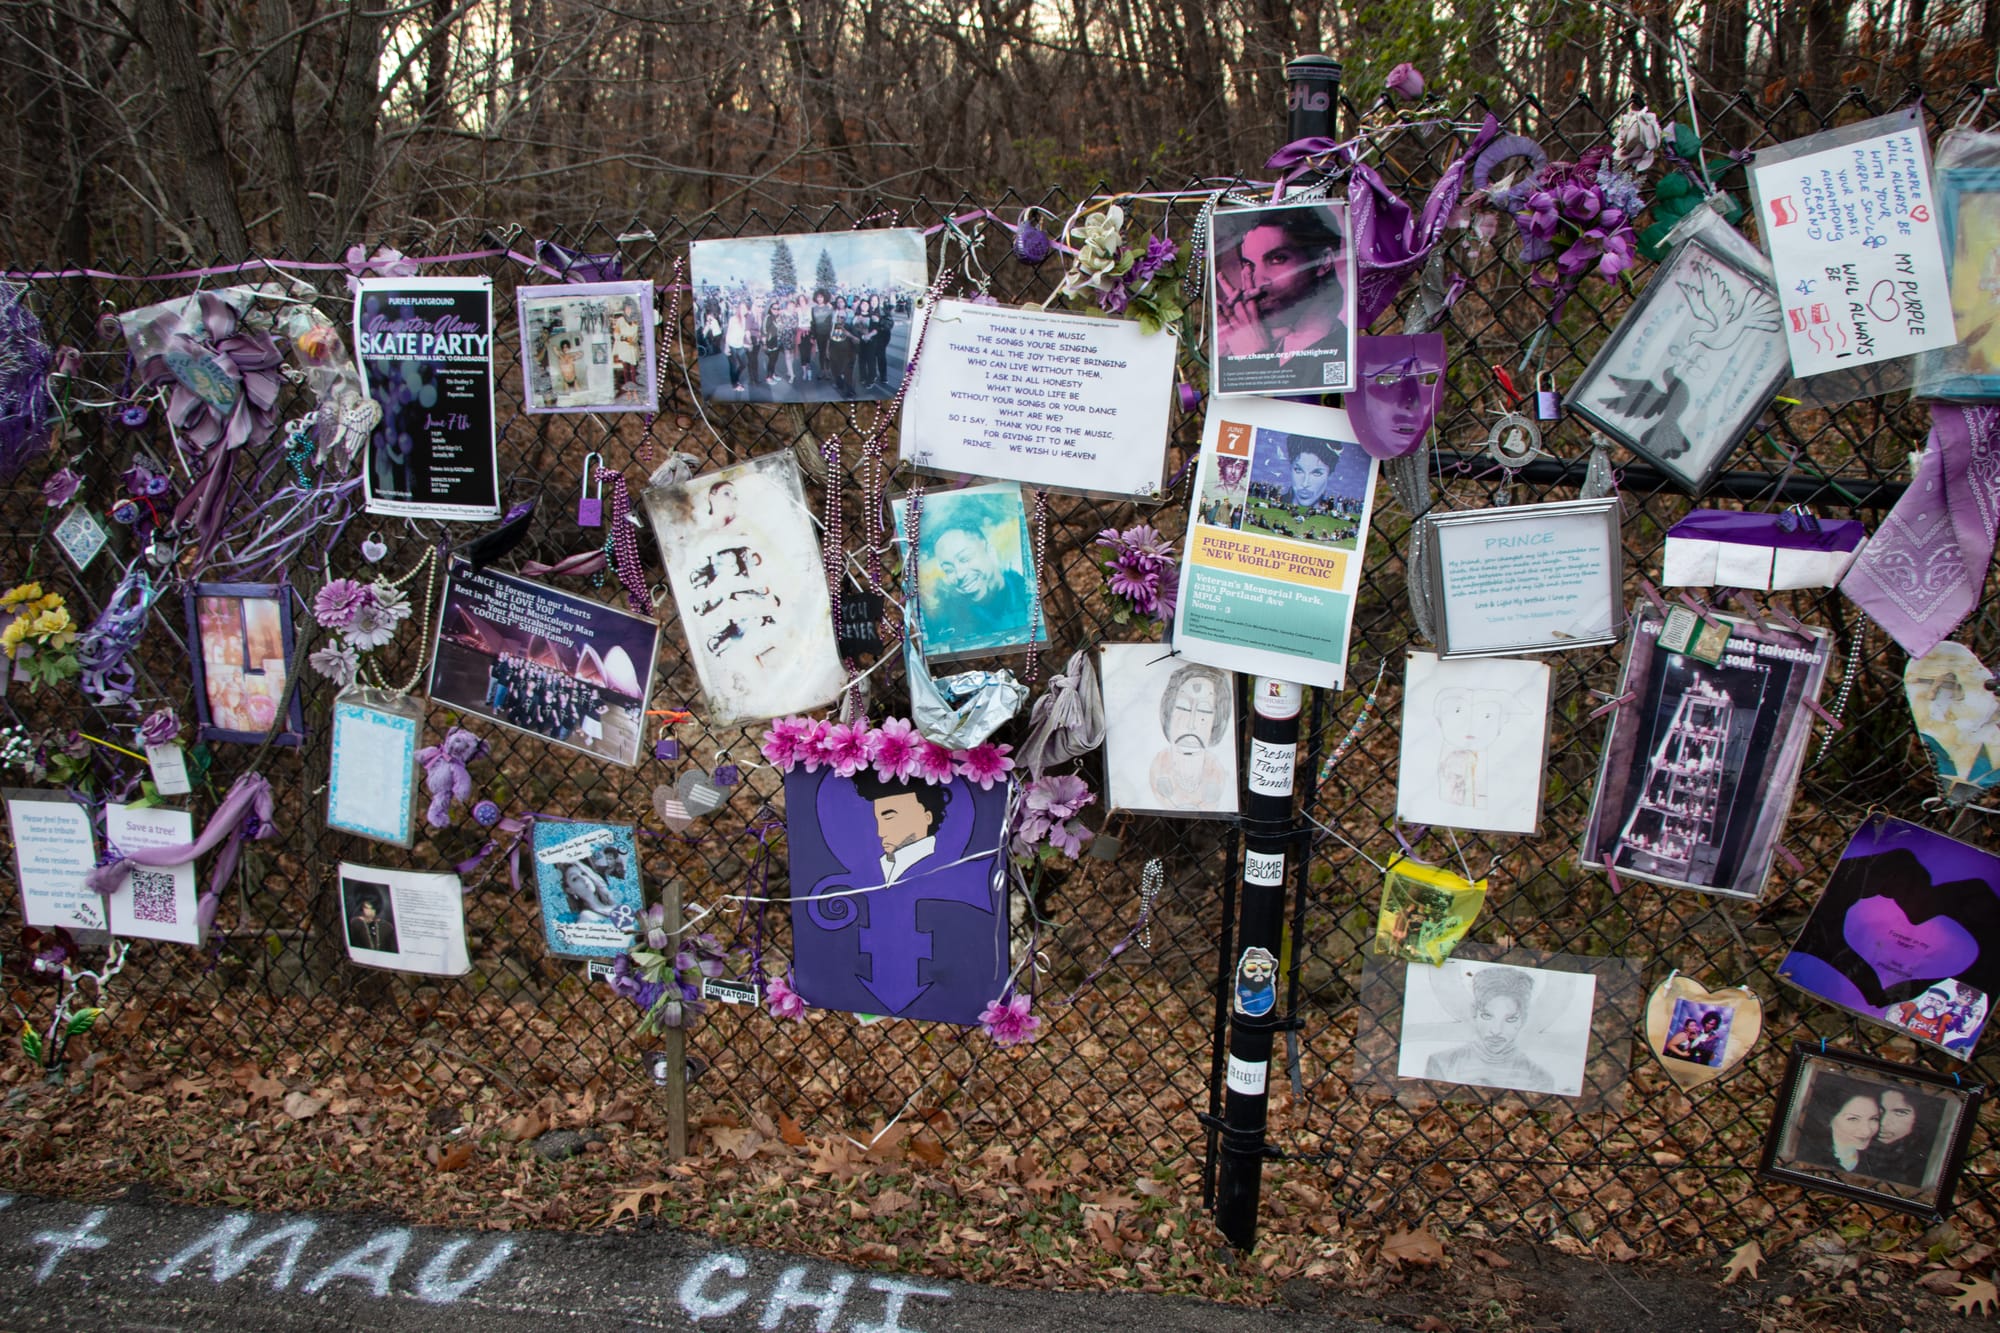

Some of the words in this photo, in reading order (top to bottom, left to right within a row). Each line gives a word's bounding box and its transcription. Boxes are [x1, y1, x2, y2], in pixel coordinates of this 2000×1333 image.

[1886, 140, 1898, 164] WILL
[1900, 137, 1913, 152] MY
[1870, 151, 1884, 178] WITH
[1836, 169, 1853, 195] YOUR
[1904, 159, 1921, 198] PURPLE
[1853, 150, 1869, 192] PURPLE
[1861, 199, 1875, 235] SOUL
[1891, 172, 1908, 214] ALWAYS
[1800, 177, 1821, 240] POLAND
[1813, 188, 1826, 219] FROM
[1874, 188, 1891, 220] YOUR
[1898, 221, 1910, 235] BE
[1825, 267, 1841, 281] BE
[1895, 254, 1914, 274] MY
[1842, 264, 1859, 295] WILL
[1898, 281, 1925, 335] PURPLE
[368, 314, 433, 337] Gangster
[433, 314, 481, 337] Glam
[990, 324, 1017, 335] THANK
[1038, 329, 1054, 338] THE
[1057, 331, 1086, 341] MUSIC
[1849, 302, 1875, 356] ALWAYS
[361, 332, 417, 354] SKATE
[422, 333, 488, 355] PARTY
[976, 335, 993, 344] THE
[995, 337, 1024, 347] SONGS
[1027, 340, 1056, 351] YOU'RE
[1059, 344, 1097, 354] SINGING
[949, 343, 980, 354] THANKS
[990, 349, 1005, 357] ALL
[1008, 351, 1024, 360] THE
[1026, 353, 1044, 361] JOY
[1047, 354, 1081, 365] THEY'RE
[1084, 358, 1127, 369] BRINGING
[968, 357, 988, 367] WHO
[989, 360, 1007, 369] CAN
[1009, 362, 1029, 372] LIVE
[1032, 365, 1073, 376] WITHOUT
[1076, 370, 1103, 380] THEM,
[986, 383, 1011, 393] WHAT
[1015, 386, 1045, 397] WOULD
[1047, 390, 1066, 399] LIFE
[992, 374, 1009, 382] ASK
[1025, 376, 1040, 385] ALL
[1042, 378, 1083, 389] HONESTY
[950, 391, 989, 402] WITHOUT
[992, 396, 1014, 405] YOUR
[1017, 399, 1046, 409] SONGS
[1063, 404, 1086, 413] YOUR
[1089, 406, 1117, 416] DANCE
[424, 413, 446, 430] June
[999, 408, 1023, 418] WHAT
[1027, 412, 1043, 420] ARE
[1046, 414, 1064, 422] WE?
[948, 414, 960, 422] SO
[970, 417, 988, 427] SAY,
[995, 420, 1022, 430] THANK
[1025, 423, 1043, 432] YOU
[1045, 425, 1062, 434] FOR
[1065, 428, 1081, 436] THE
[1084, 429, 1115, 440] MUSIC,
[984, 429, 1000, 438] FOR
[1002, 433, 1033, 442] GIVING
[1036, 435, 1046, 443] IT
[1227, 425, 1244, 435] JUNE
[1227, 433, 1241, 451] 7
[1010, 444, 1022, 452] WE
[1025, 446, 1049, 456] WISH
[1061, 450, 1096, 461] HEAVEN!
[1485, 532, 1555, 550] PRINCE
[1203, 537, 1250, 554] PURPLE
[1253, 545, 1335, 569] PLAYGROUND
[1288, 563, 1332, 579] PICNIC
[1194, 583, 1216, 593] 6335
[1219, 586, 1263, 603] Portland
[1195, 573, 1241, 588] Veteran's
[1243, 581, 1292, 599] Memorial
[495, 590, 509, 601] WE
[511, 594, 533, 609] LOVE
[535, 603, 555, 616] YOU
[496, 581, 504, 590] is
[505, 584, 536, 600] forever
[538, 595, 546, 605] in
[547, 601, 562, 610] our
[564, 604, 592, 620] hearts
[1192, 591, 1222, 602] MPLS
[1192, 600, 1217, 612] Noon
[455, 584, 472, 596] Rest
[474, 590, 483, 600] in
[484, 594, 508, 608] Peace
[509, 603, 525, 614] Our
[526, 608, 574, 631] Musicology
[575, 624, 595, 637] Man
[488, 604, 506, 616] Your
[509, 612, 562, 634] Australasian
[469, 604, 518, 626] "COOLEST"
[519, 622, 545, 637] SHHH
[545, 630, 575, 648] family
[1726, 637, 1756, 654] ants
[1758, 641, 1823, 665] salvation
[1254, 743, 1294, 759] Fresno
[1256, 759, 1290, 775] Purple
[1252, 771, 1292, 790] Family
[126, 821, 146, 832] Save
[156, 826, 176, 836] tree!
[1247, 867, 1282, 879] SQUAD
[1250, 857, 1282, 869] BUMP
[590, 964, 615, 975] FUNKA
[705, 984, 756, 1003] FUNKATOPIA
